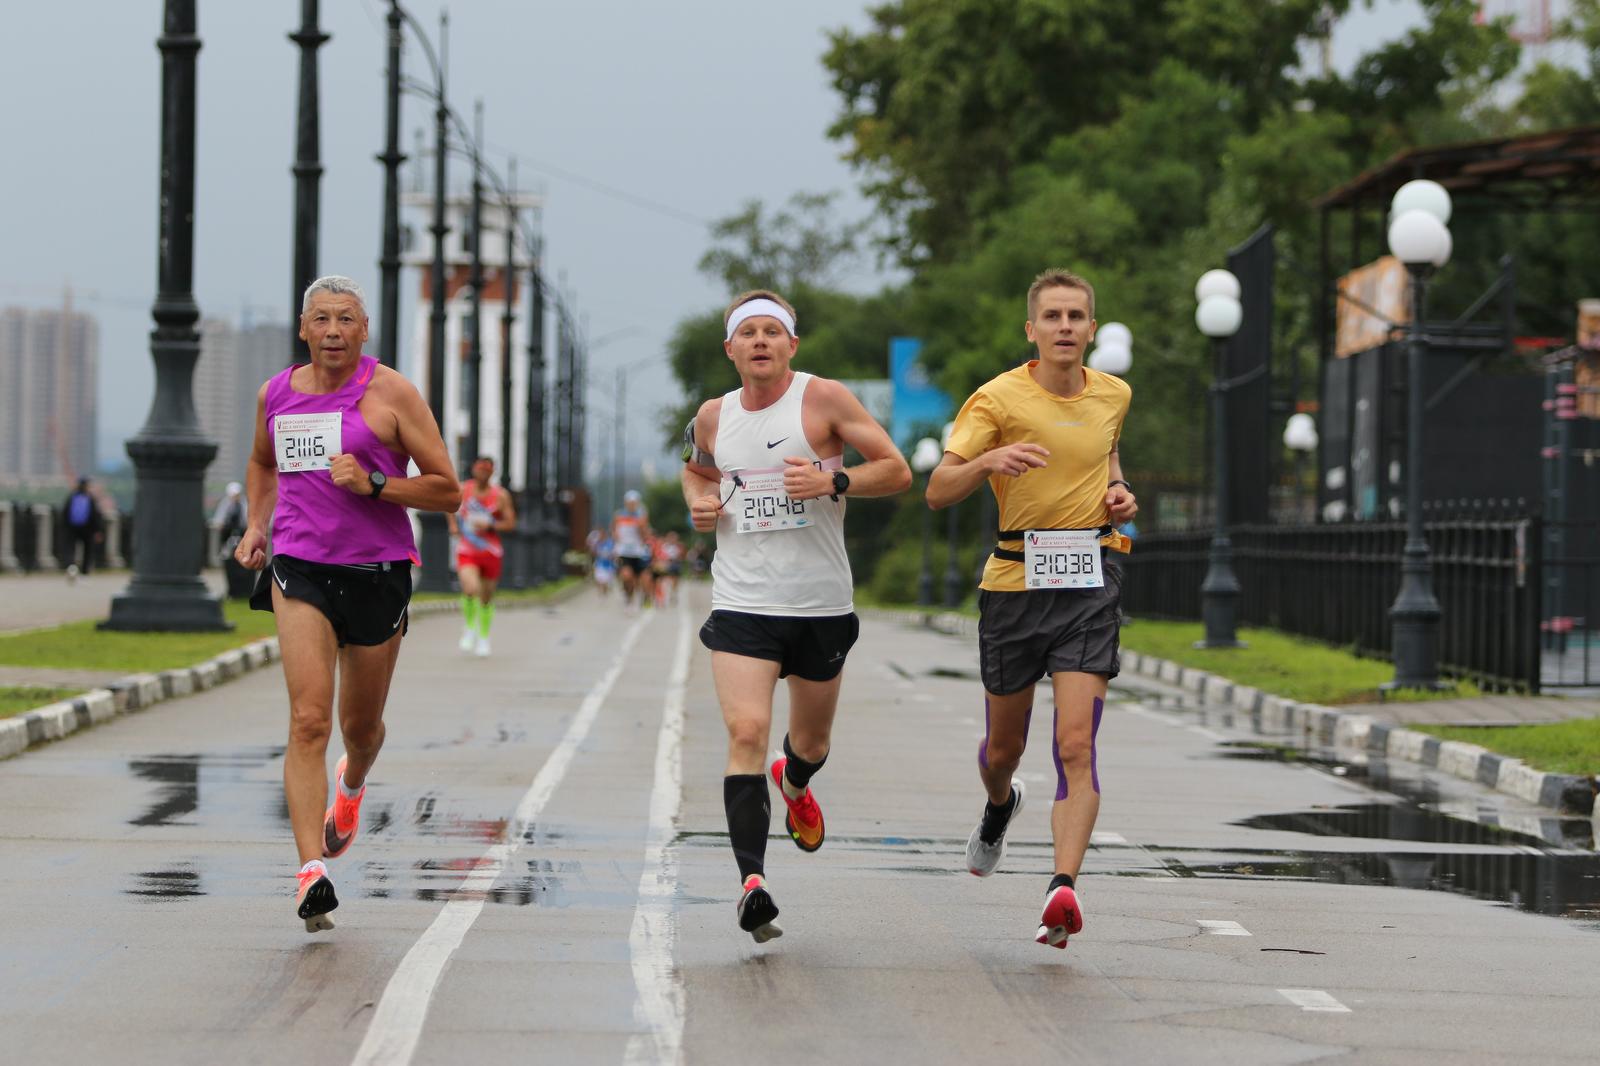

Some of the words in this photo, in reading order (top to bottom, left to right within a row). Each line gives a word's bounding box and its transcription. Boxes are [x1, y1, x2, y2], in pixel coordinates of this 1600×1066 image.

[285, 435, 325, 459] 21116
[744, 495, 805, 519] 21048
[1034, 553, 1094, 575] 21038
